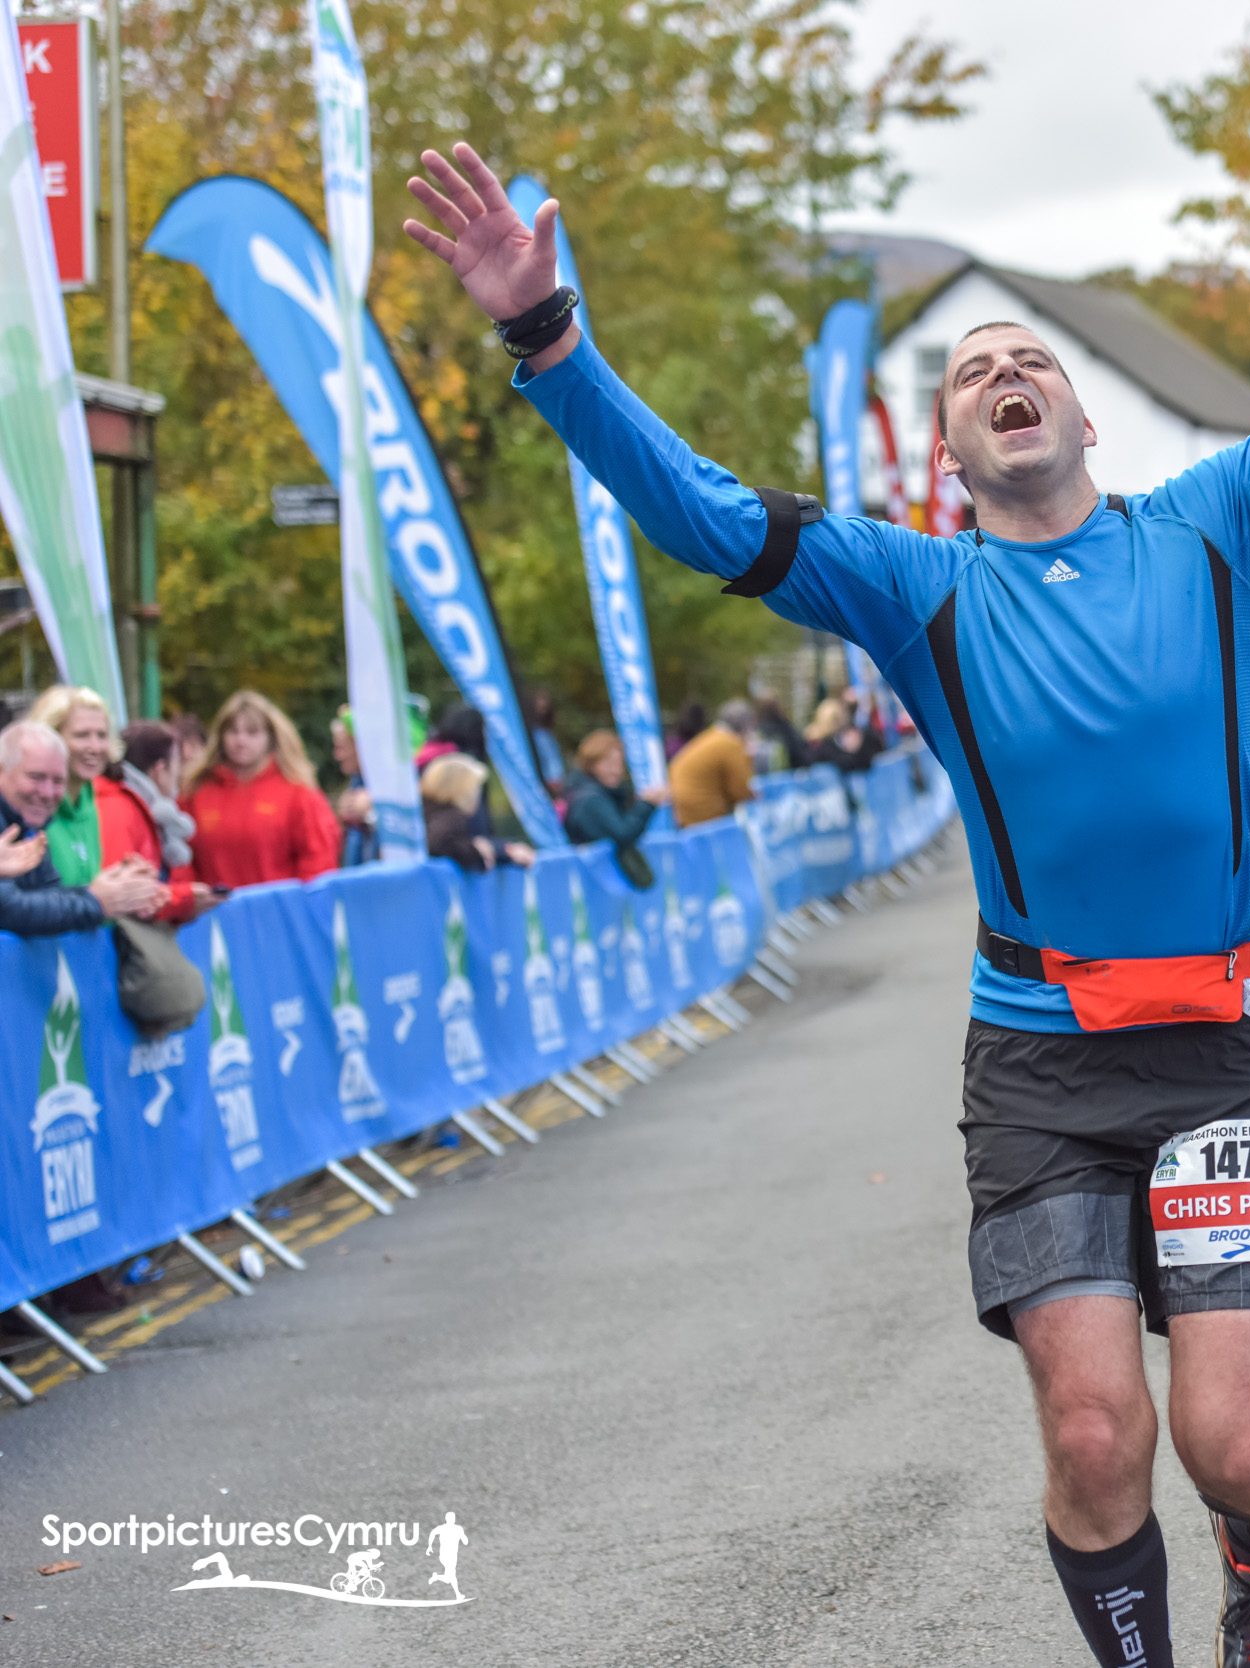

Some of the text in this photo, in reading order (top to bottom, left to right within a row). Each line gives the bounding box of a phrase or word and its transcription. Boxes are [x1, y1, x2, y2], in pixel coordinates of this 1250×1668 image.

[1042, 571, 1081, 583] adidas
[1182, 1126, 1238, 1144] MARATHON
[1155, 1168, 1177, 1179] ERYRI
[1163, 1195, 1232, 1220] CHRIS
[1095, 1585, 1148, 1668] lenji
